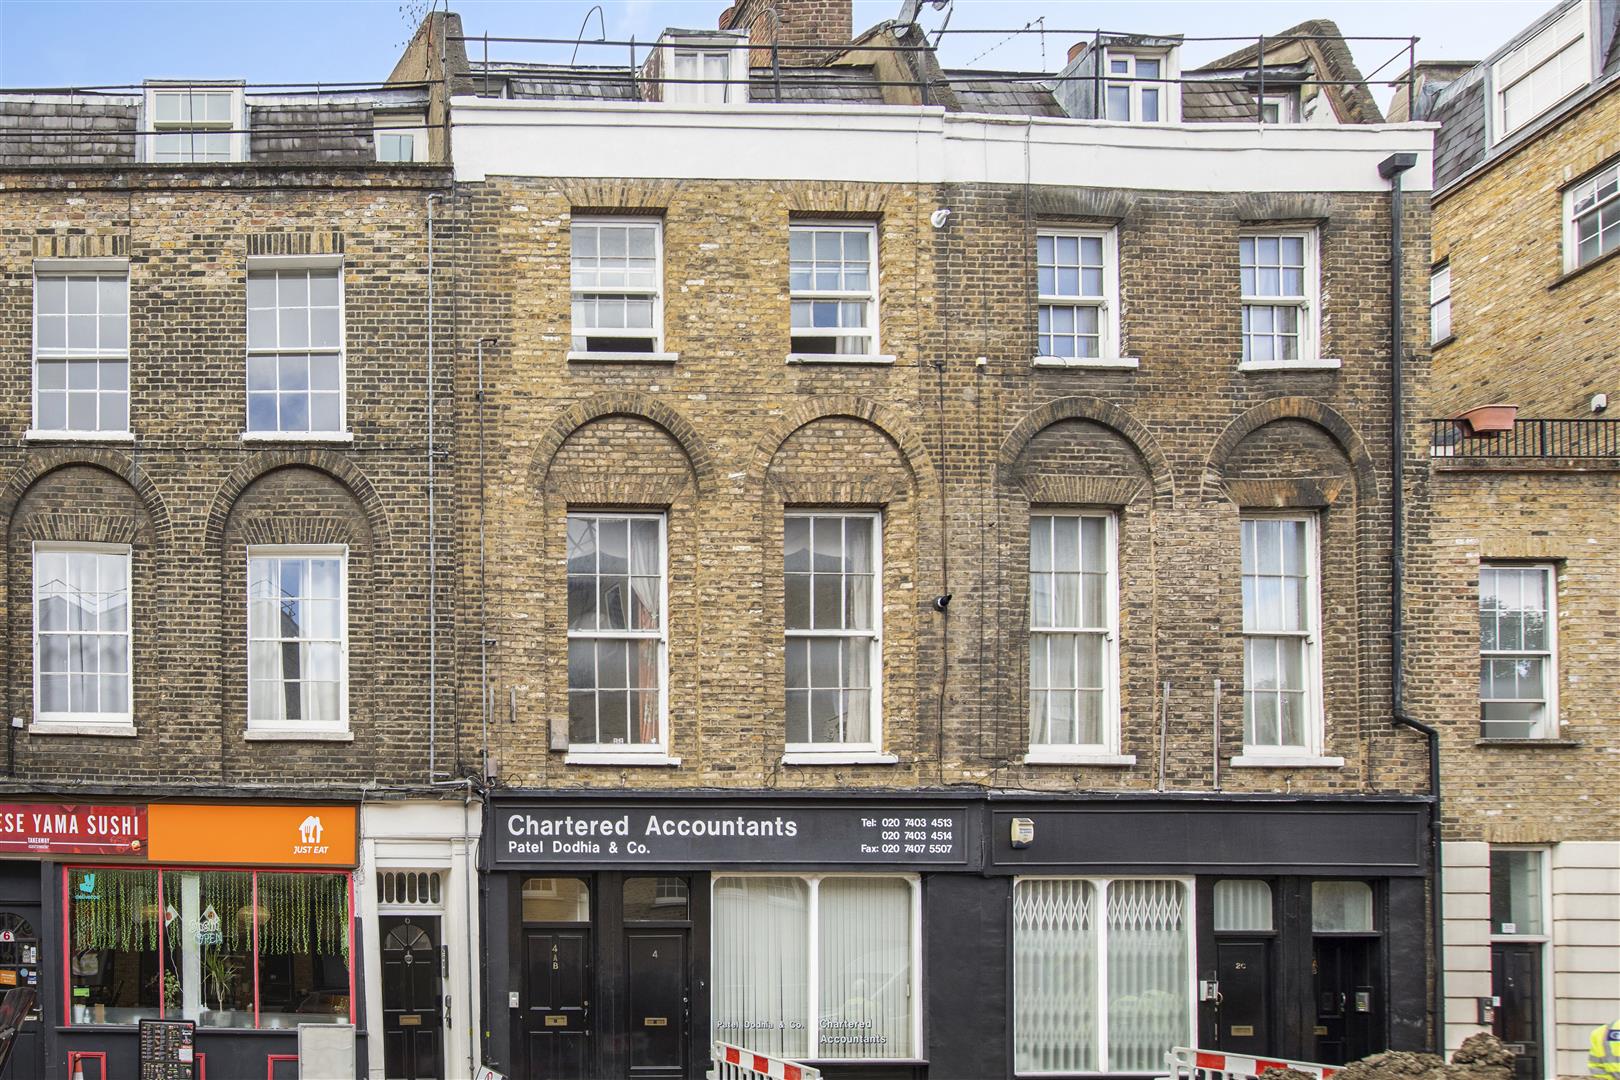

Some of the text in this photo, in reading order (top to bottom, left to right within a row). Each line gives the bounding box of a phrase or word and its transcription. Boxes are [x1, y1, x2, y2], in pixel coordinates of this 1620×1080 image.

[0, 813, 139, 836] SE YAMA SUSHI
[507, 814, 798, 837] Chartered Accountants
[861, 818, 953, 827] Tel: 020 7403 4513
[881, 831, 952, 840] 020 7403 4514
[293, 846, 329, 855] JUST EAT
[508, 841, 651, 854] Patel Dodhia & Co.
[861, 844, 953, 853] Fax: 020 7407 5507
[3, 931, 11, 941] 6
[652, 950, 658, 958] 4
[716, 1020, 740, 1030] Patel
[819, 1018, 873, 1030] Chartered
[819, 1034, 887, 1045] Accountants
